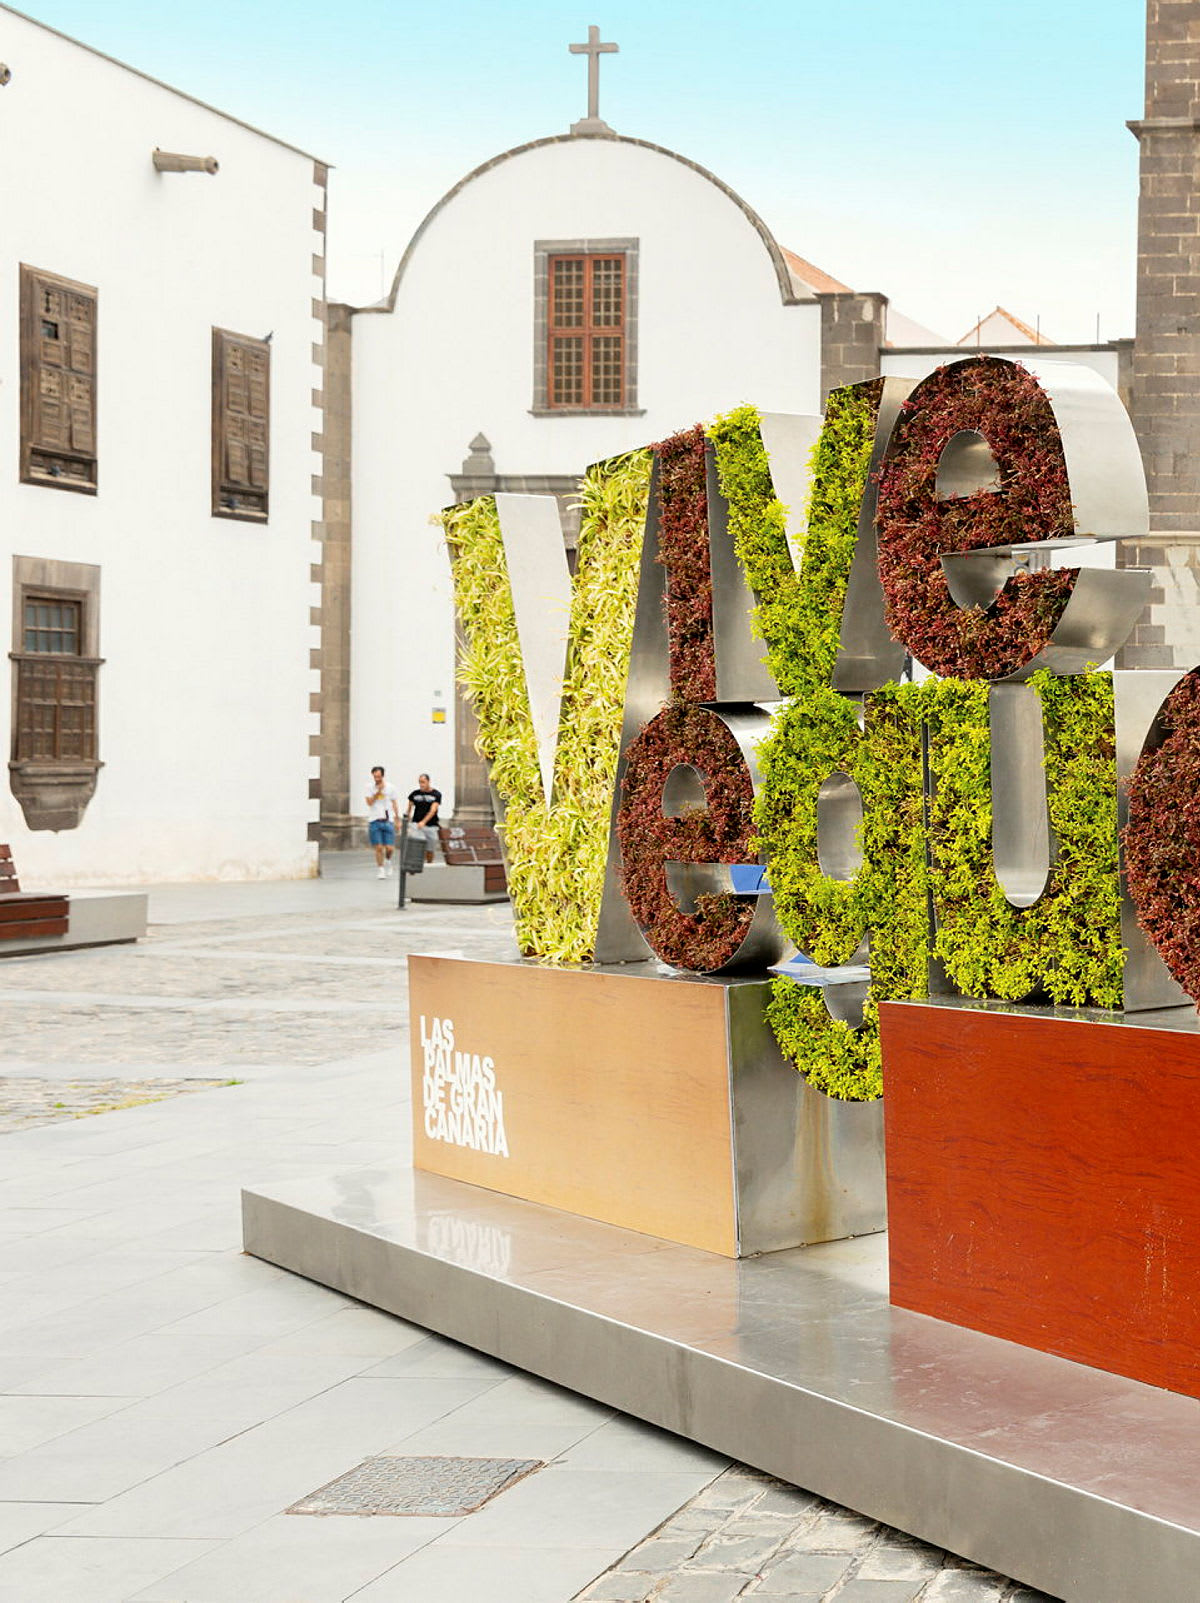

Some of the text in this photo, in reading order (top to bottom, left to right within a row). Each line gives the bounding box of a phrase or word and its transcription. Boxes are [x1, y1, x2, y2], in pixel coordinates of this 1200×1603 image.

[420, 1015, 455, 1051] LAS
[424, 1039, 496, 1092] PALMAS
[423, 1075, 504, 1122] DE GRAN
[424, 1104, 510, 1158] CANARIA
